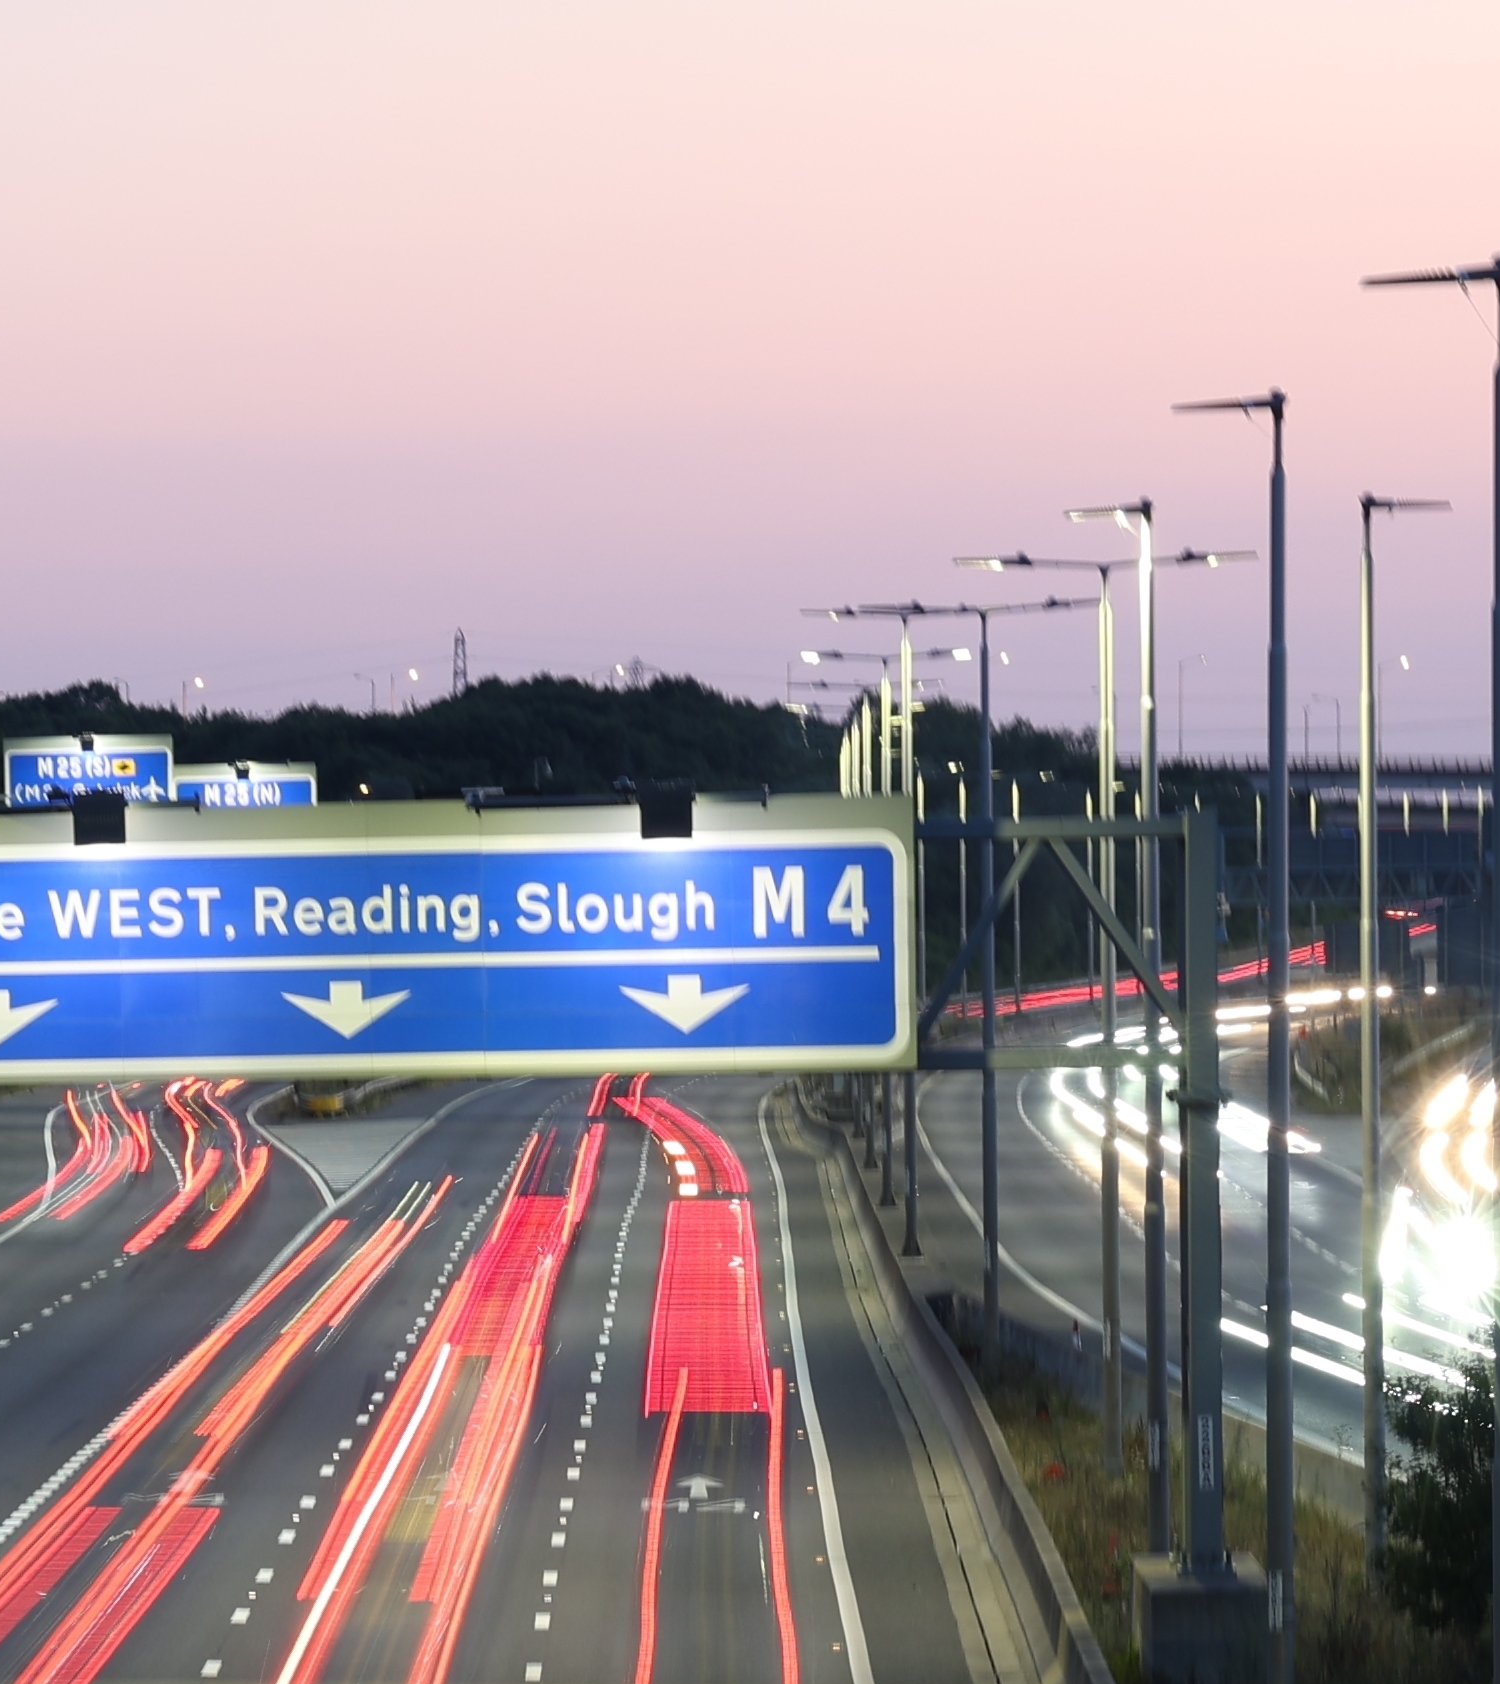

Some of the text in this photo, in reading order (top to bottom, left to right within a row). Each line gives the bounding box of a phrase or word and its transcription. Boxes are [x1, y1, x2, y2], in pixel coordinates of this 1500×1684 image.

[47, 886, 236, 941] WEST,
[255, 884, 499, 942] Reading,
[517, 880, 715, 942] Slough
